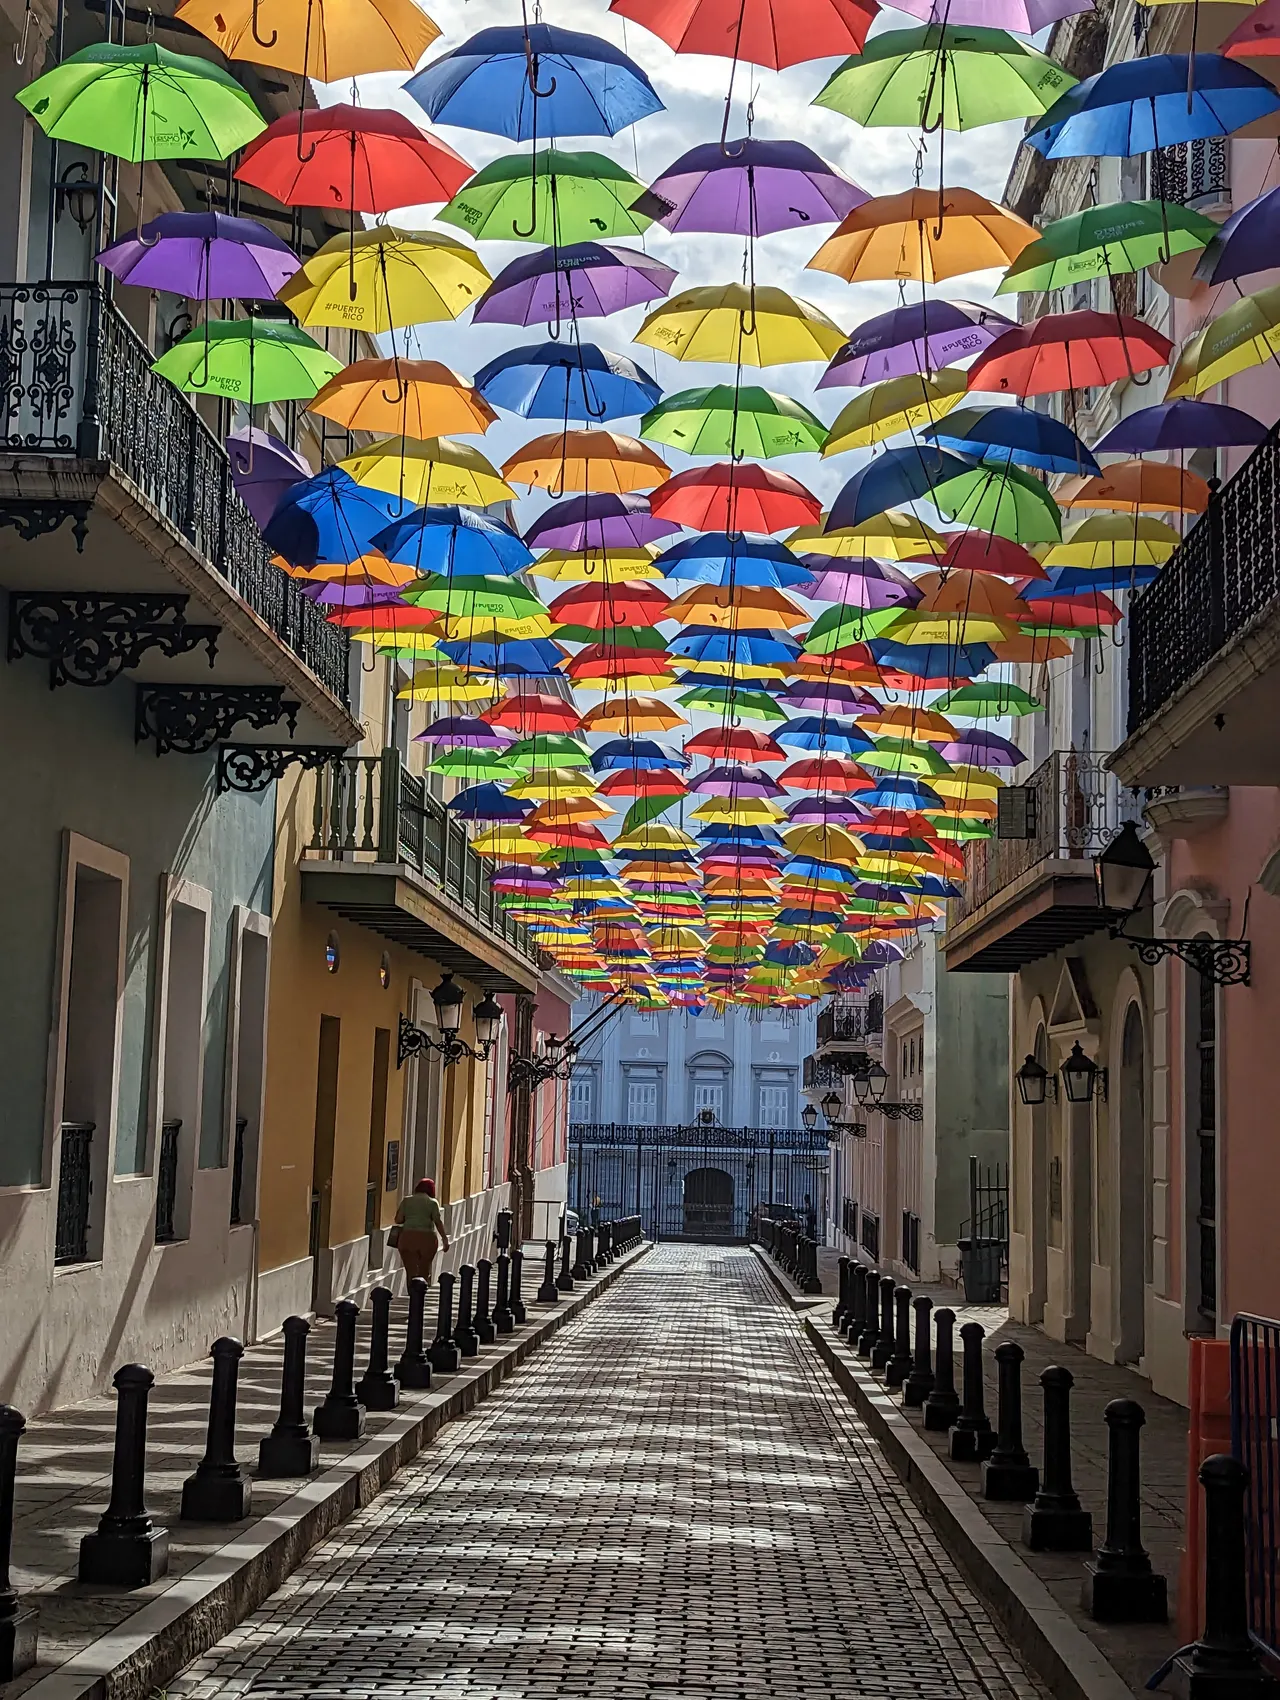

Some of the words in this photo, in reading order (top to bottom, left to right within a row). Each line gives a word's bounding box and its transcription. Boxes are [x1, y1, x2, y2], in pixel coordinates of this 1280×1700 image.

[325, 302, 365, 315] #PUERTO
[342, 312, 363, 322] RICO
[941, 333, 979, 353] #PUERTO
[962, 339, 983, 350] RICO
[207, 375, 242, 387] PUERTO
[219, 383, 240, 393] RICO
